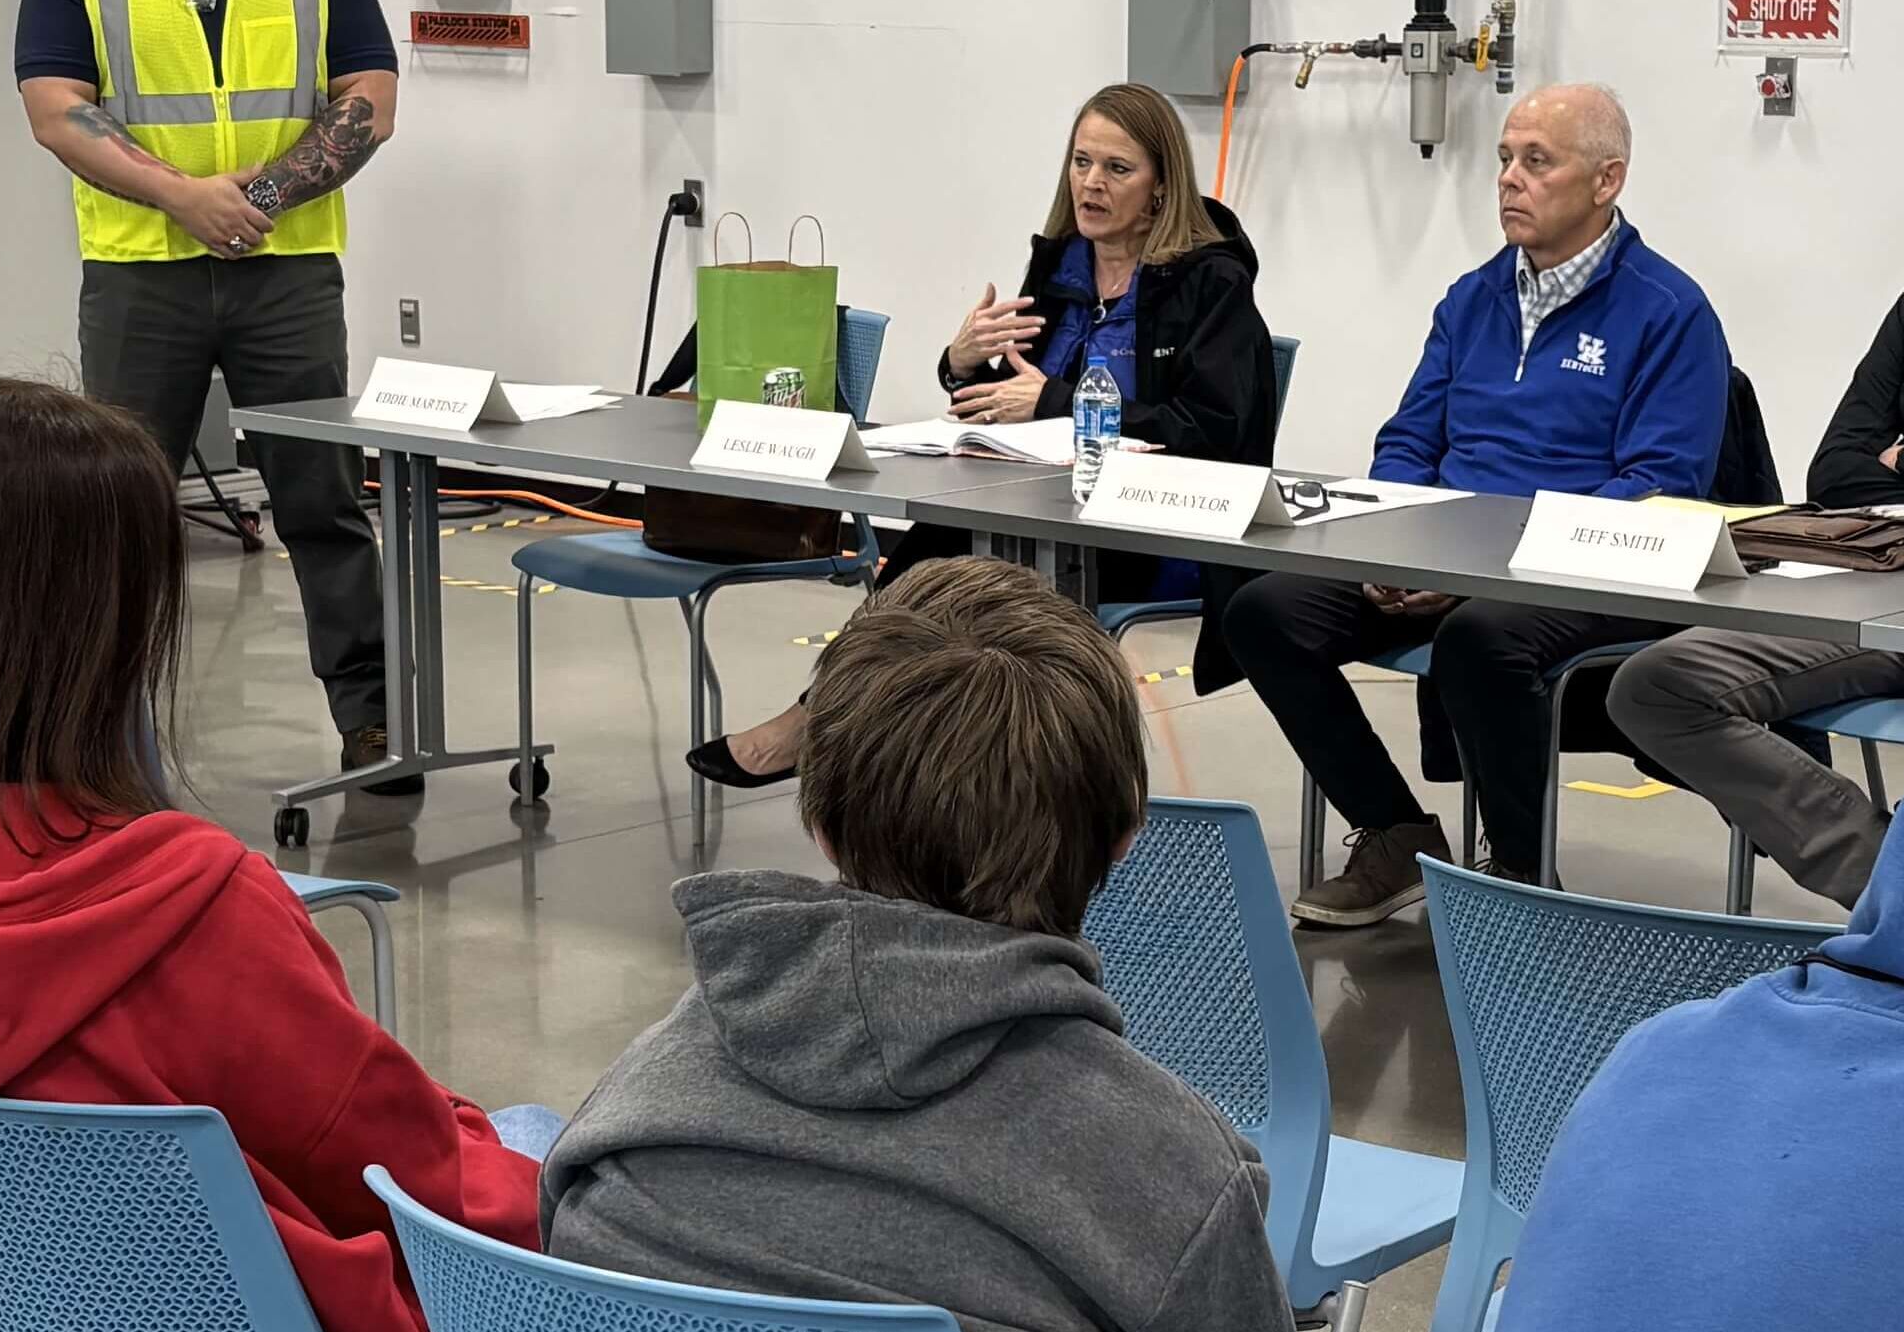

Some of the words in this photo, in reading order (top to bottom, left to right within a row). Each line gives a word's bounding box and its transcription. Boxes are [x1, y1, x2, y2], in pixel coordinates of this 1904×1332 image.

[375, 391, 409, 406] EDDIE
[410, 397, 468, 414] MARTINEZ
[723, 438, 765, 454] LESLIE
[767, 442, 816, 461] WAUGH
[1117, 486, 1157, 503] JOHN
[1159, 491, 1230, 513] TRAYLOR
[1570, 527, 1609, 545] JEFF
[1610, 532, 1665, 553] SMITH
